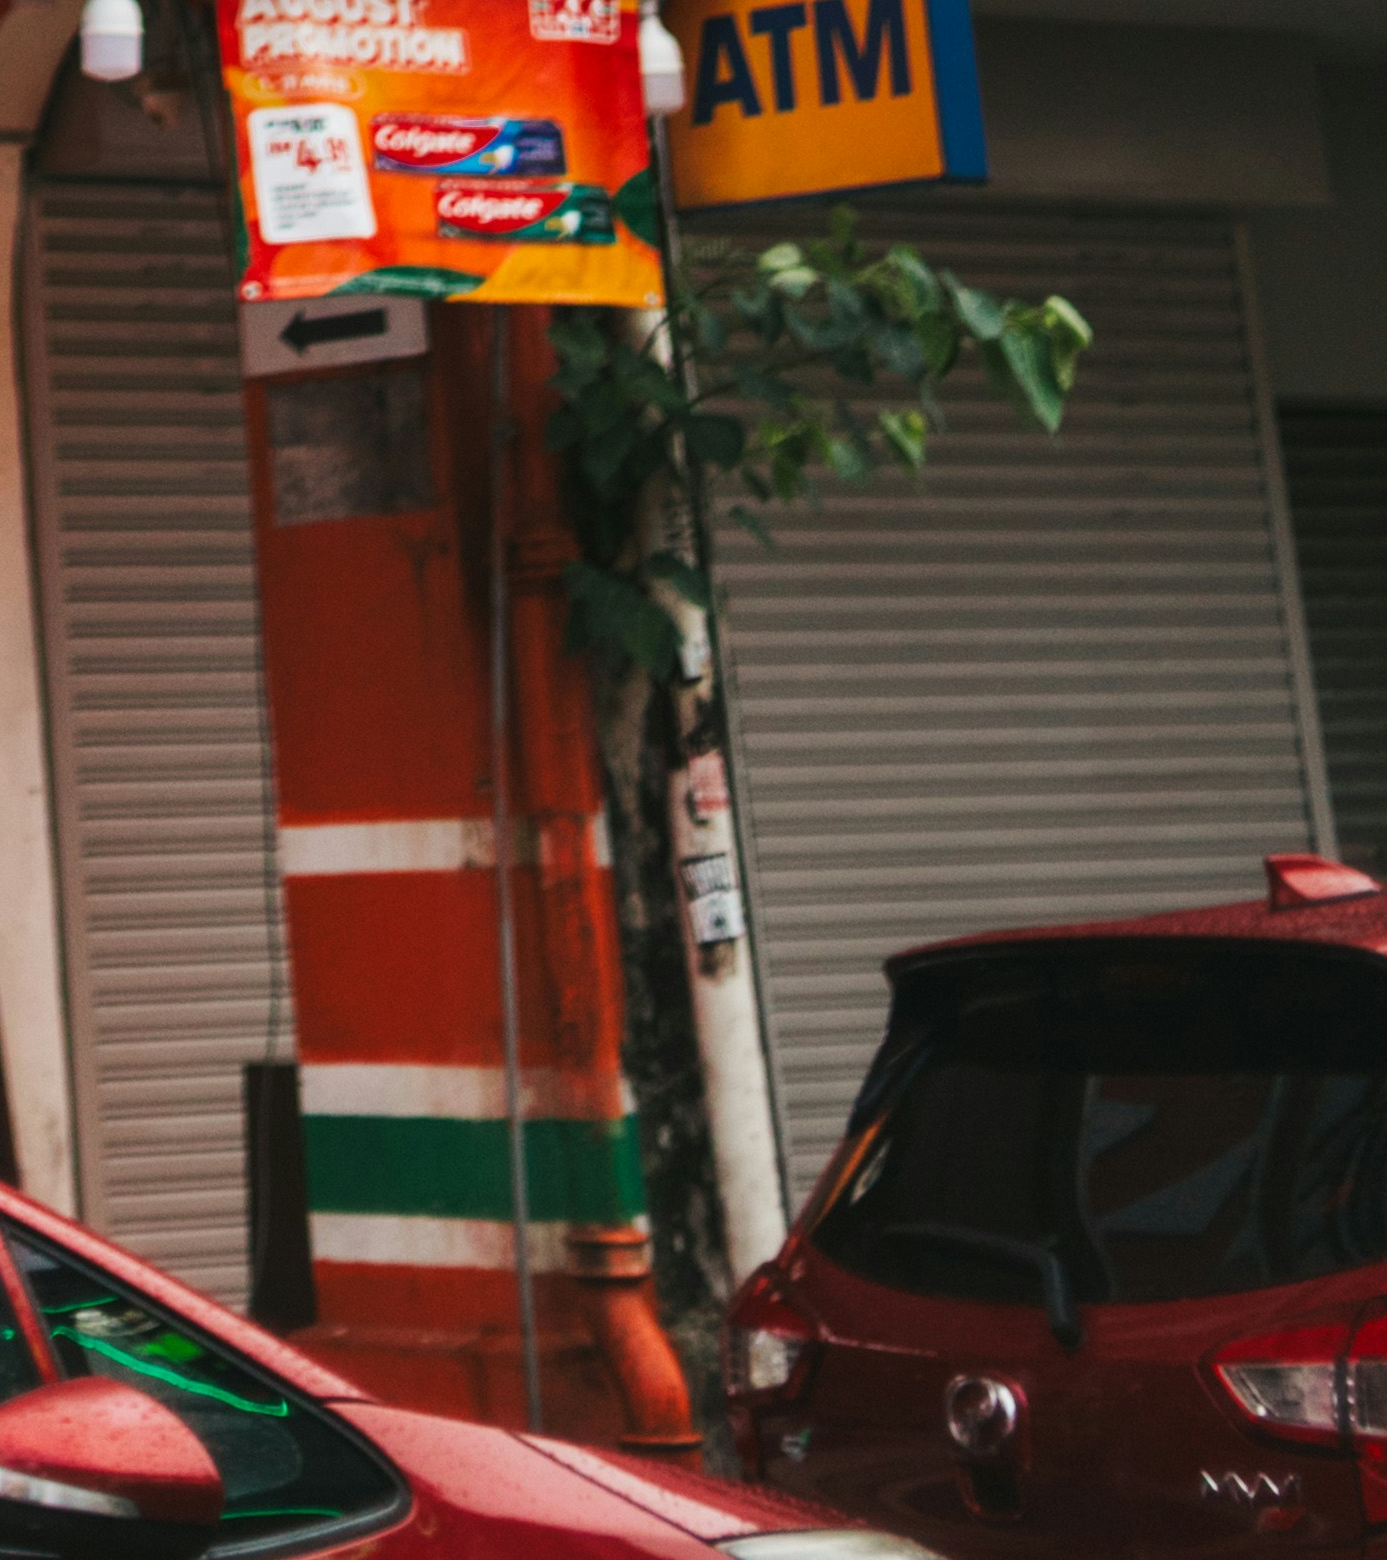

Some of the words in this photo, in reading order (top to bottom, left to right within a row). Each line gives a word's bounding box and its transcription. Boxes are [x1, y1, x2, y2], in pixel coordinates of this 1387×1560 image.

[243, 22, 468, 70] PROMOTION
[375, 124, 477, 159] Colgate
[437, 191, 543, 225] Colgate
